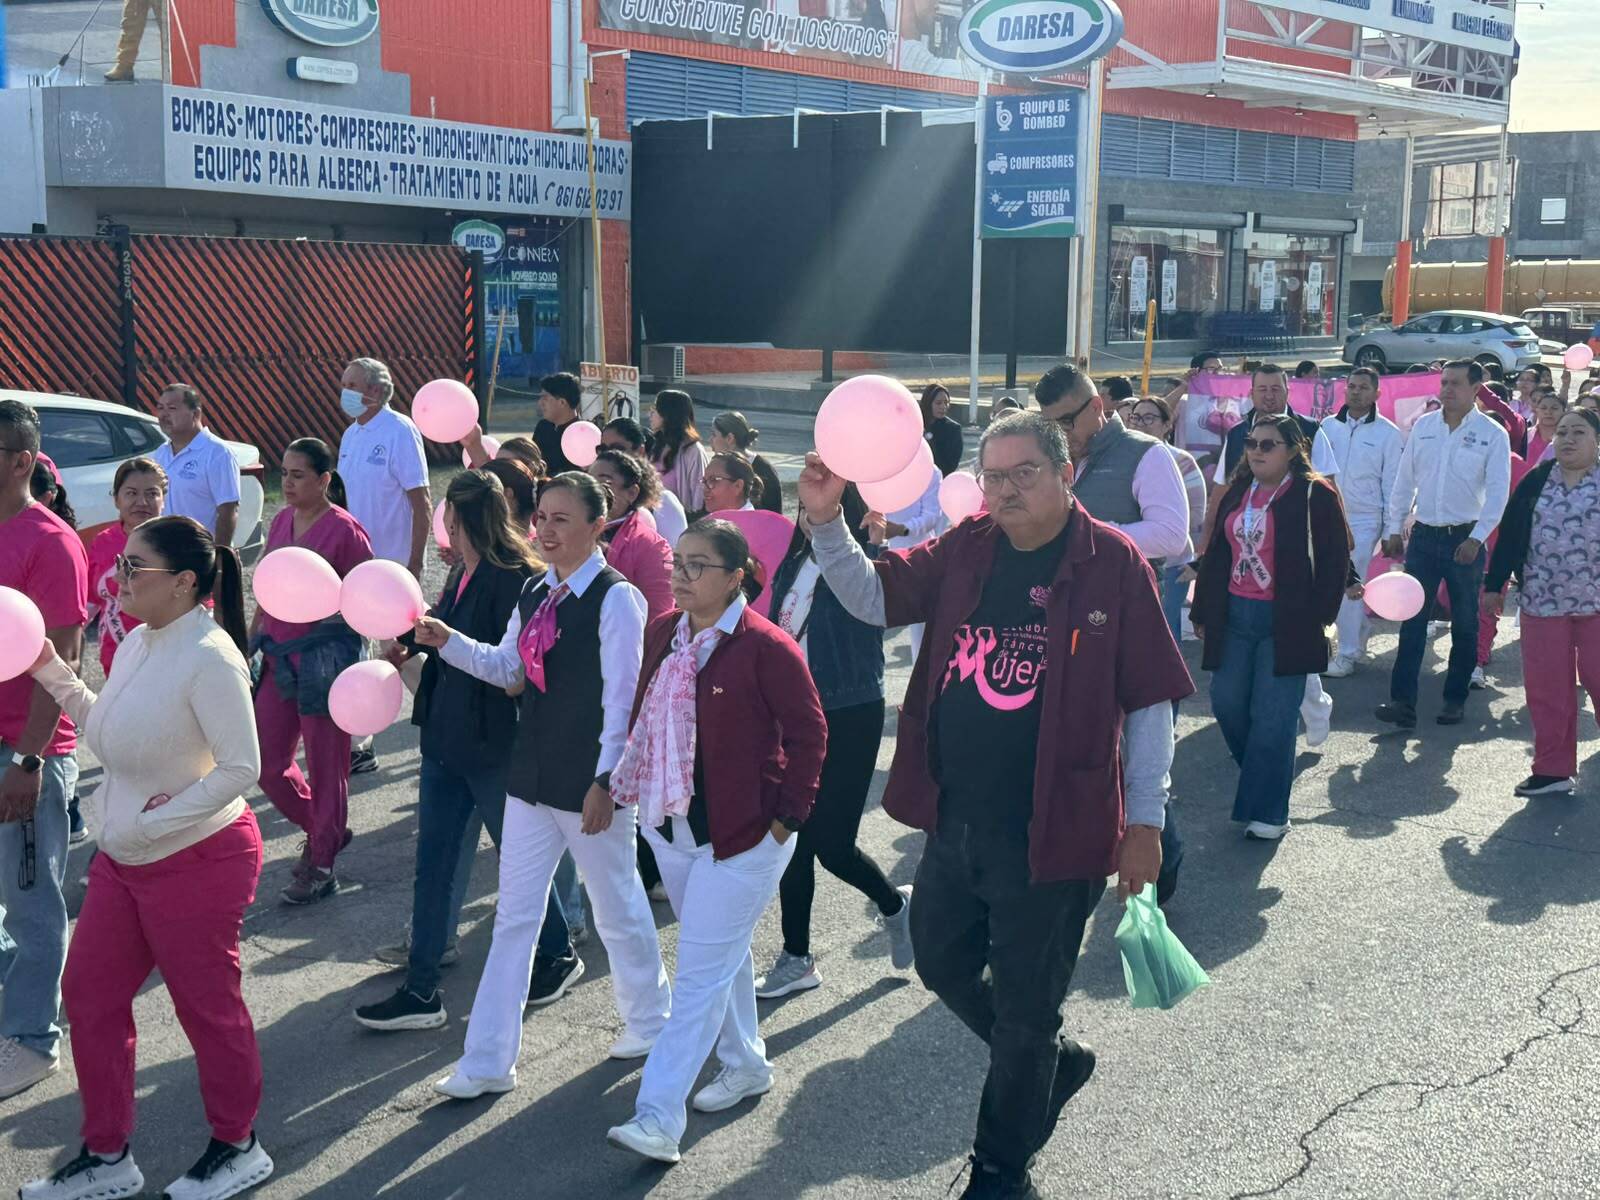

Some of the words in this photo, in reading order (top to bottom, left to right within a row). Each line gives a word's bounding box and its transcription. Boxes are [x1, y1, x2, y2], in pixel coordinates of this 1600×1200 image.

[620, 0, 744, 36] CONSTRUYE
[747, 8, 788, 41] CON
[996, 12, 1075, 42] DARESA
[1019, 99, 1055, 116] EQUIPO
[1057, 98, 1071, 112] DE
[1023, 114, 1066, 130] BOMBEO
[171, 96, 237, 138] BOMBAS
[245, 105, 313, 146] MOTORES
[320, 114, 416, 155] COMPRESORES
[422, 126, 529, 167] HIDRONEUMATICOS
[1009, 154, 1075, 170] COMPRESORES
[193, 144, 262, 184] EQUIPOS
[268, 151, 311, 188] PARA
[317, 155, 382, 194] ALBERCA
[390, 161, 481, 201] TRATAMIENTO
[486, 171, 501, 203] DE
[508, 173, 539, 205] AGUA
[555, 185, 575, 209] 861
[609, 189, 624, 211] 97
[1026, 187, 1071, 204] ENERGÍA
[1030, 203, 1065, 217] SOLAR
[465, 233, 497, 249] DARESA
[1003, 638, 1045, 653] Cánce
